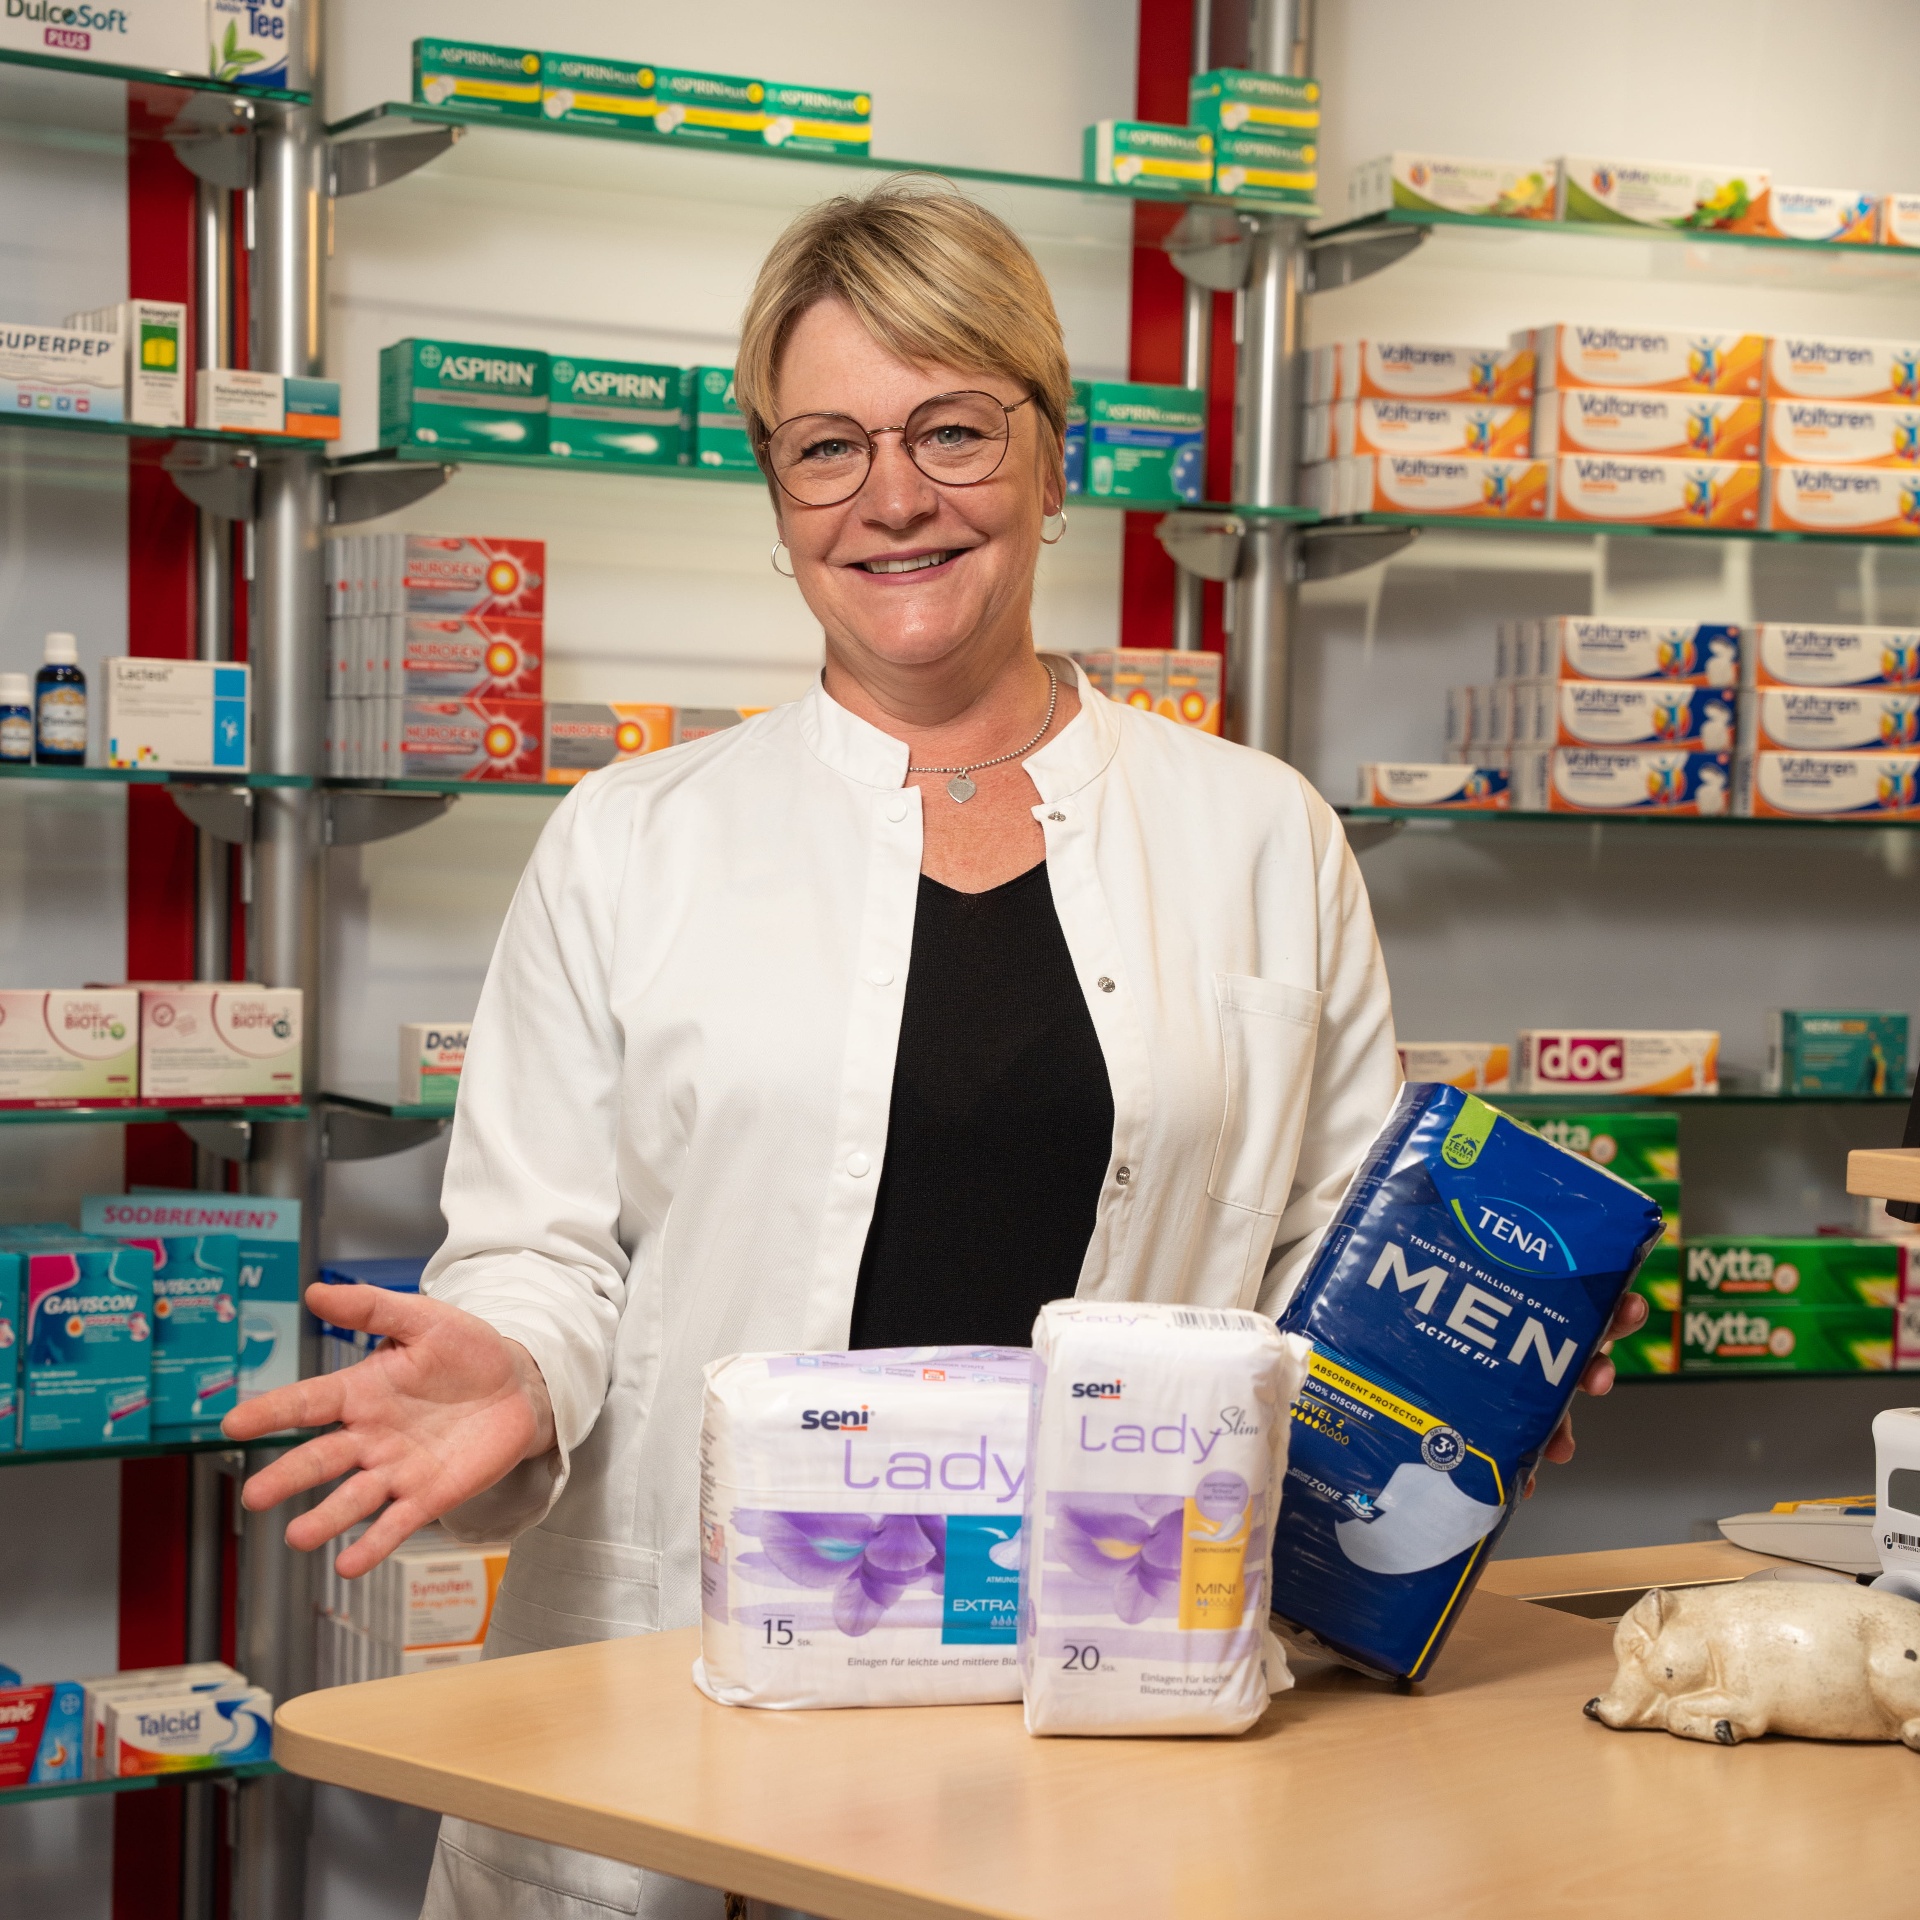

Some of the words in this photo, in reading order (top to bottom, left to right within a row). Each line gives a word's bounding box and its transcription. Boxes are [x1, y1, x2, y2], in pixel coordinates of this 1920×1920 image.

[246, 6, 284, 39] Tee
[47, 30, 88, 48] PLUS
[440, 47, 494, 66] ASPIRIN
[560, 61, 613, 80] ASPIRIN
[1578, 327, 1668, 352] Voltaren
[1786, 340, 1873, 364] Voltaren
[1378, 344, 1455, 366] Voltaren
[438, 355, 534, 387] ASPIRIN
[571, 370, 667, 400] ASPIRIN
[1373, 402, 1449, 423] Voltaren
[1578, 394, 1668, 418] Voltaren
[1788, 405, 1874, 430] Voltaren
[1391, 458, 1467, 479] Voltaren
[1576, 460, 1666, 484] Voltaren
[1792, 469, 1880, 494] Voltaren
[1540, 1036, 1622, 1080] doc
[1450, 1138, 1474, 1158] TENA
[104, 1205, 278, 1230] SODBRENNEN?
[1477, 1205, 1549, 1261] TENA
[1410, 1234, 1456, 1264] TRUSTED
[1459, 1260, 1473, 1272] BY
[1475, 1269, 1525, 1301] MILLIONS
[1527, 1298, 1541, 1309] OF
[1686, 1248, 1774, 1290] Kytta
[153, 1277, 223, 1296] VISCON
[44, 1294, 138, 1316] GAVISCON
[1366, 1241, 1578, 1387] MEN
[1683, 1311, 1770, 1354] Kytta
[1414, 1321, 1472, 1355] ACTIVE
[1473, 1351, 1500, 1370] FIT
[1072, 1380, 1121, 1398] seni
[1304, 1378, 1329, 1398] 100%
[1329, 1391, 1375, 1421] DISCREET
[1313, 1362, 1369, 1399] ABSORBENT
[1369, 1392, 1424, 1428] PROTECTOR
[801, 1405, 869, 1430] seni
[1209, 1406, 1260, 1436] Slim
[1295, 1397, 1332, 1423] LEVEL
[1335, 1418, 1345, 1429] 2
[1080, 1413, 1222, 1464] Lady
[1430, 1427, 1442, 1437] DRY
[844, 1435, 1026, 1503] Lady
[1308, 1478, 1343, 1501] ZONE
[1195, 1583, 1237, 1594] MINI
[953, 1599, 1016, 1612] EXTRA
[763, 1619, 793, 1646] 15
[847, 1657, 887, 1669] Einlagen
[890, 1657, 905, 1668] für
[908, 1657, 939, 1667] leichte
[942, 1657, 959, 1666] und
[961, 1657, 999, 1667] mittlere
[1062, 1645, 1100, 1671] 20
[1140, 1672, 1183, 1685] Einlagen
[136, 1711, 201, 1737] Talcid
